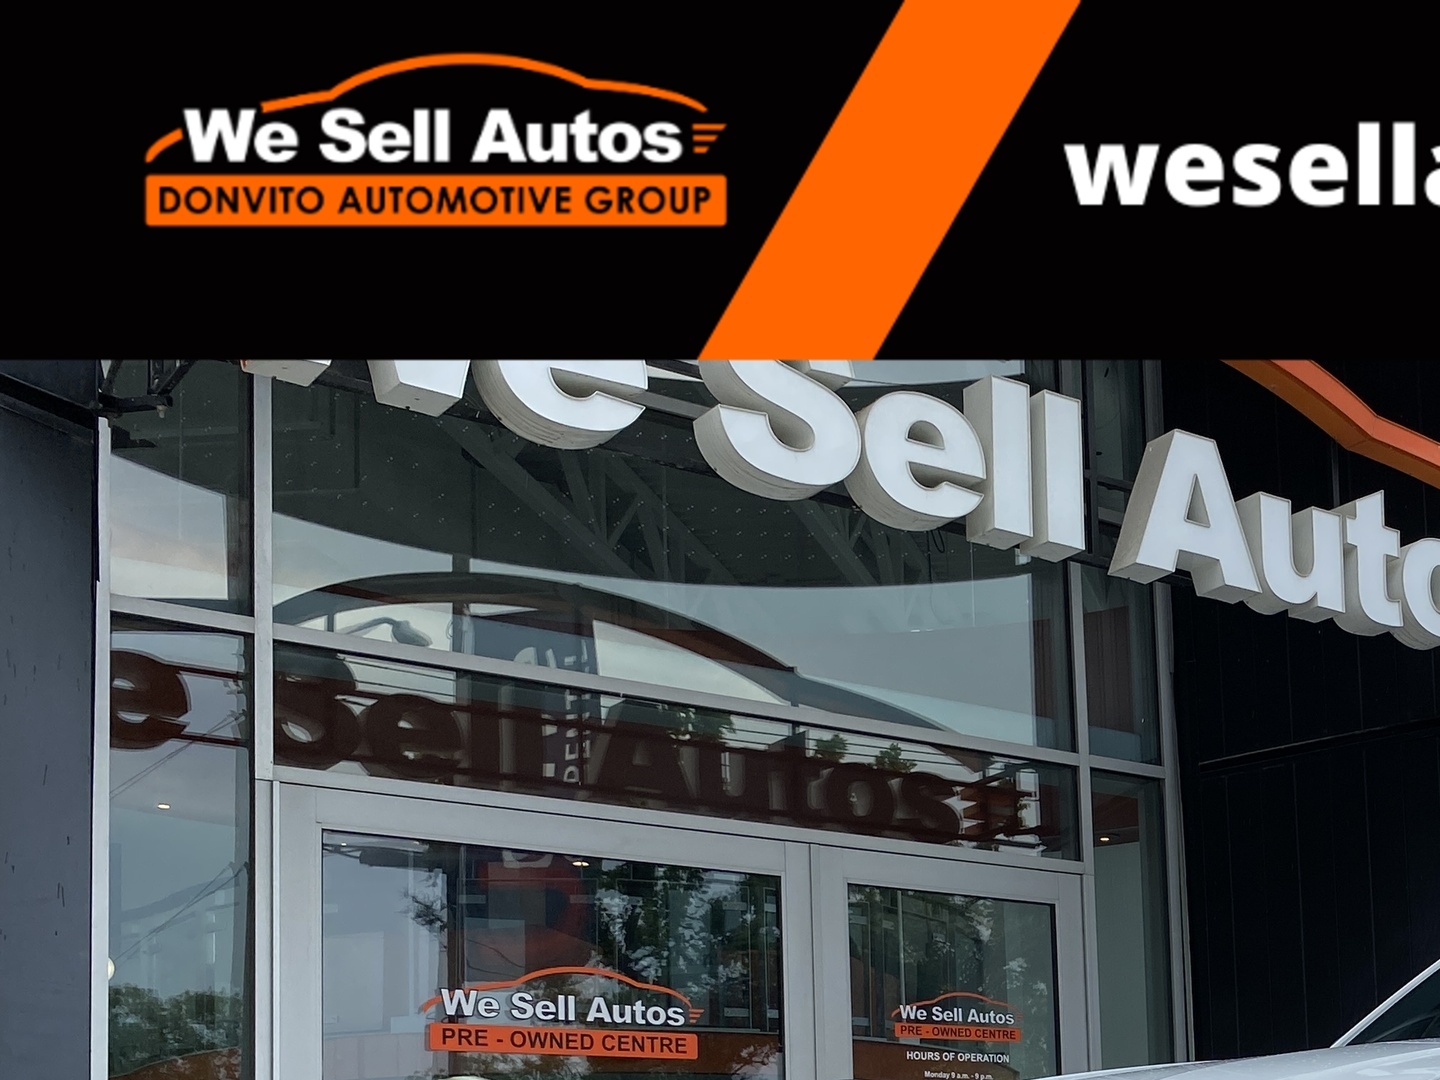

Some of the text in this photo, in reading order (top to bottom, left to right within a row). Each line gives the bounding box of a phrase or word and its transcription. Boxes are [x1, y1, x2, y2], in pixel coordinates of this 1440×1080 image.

[693, 359, 1086, 562] Sell
[440, 988, 686, 1026] We Sell Autos
[899, 1004, 1015, 1025] We Sell Autos
[442, 1028, 489, 1046] PRE
[510, 1030, 594, 1050] OWNED
[602, 1034, 687, 1054] CENTRE
[900, 1025, 923, 1036] PRE
[931, 1026, 972, 1038] OWNED
[974, 1028, 1016, 1040] CENTRE
[906, 1050, 1010, 1064] HOURS OF OPERATION
[924, 1070, 950, 1080] Monday
